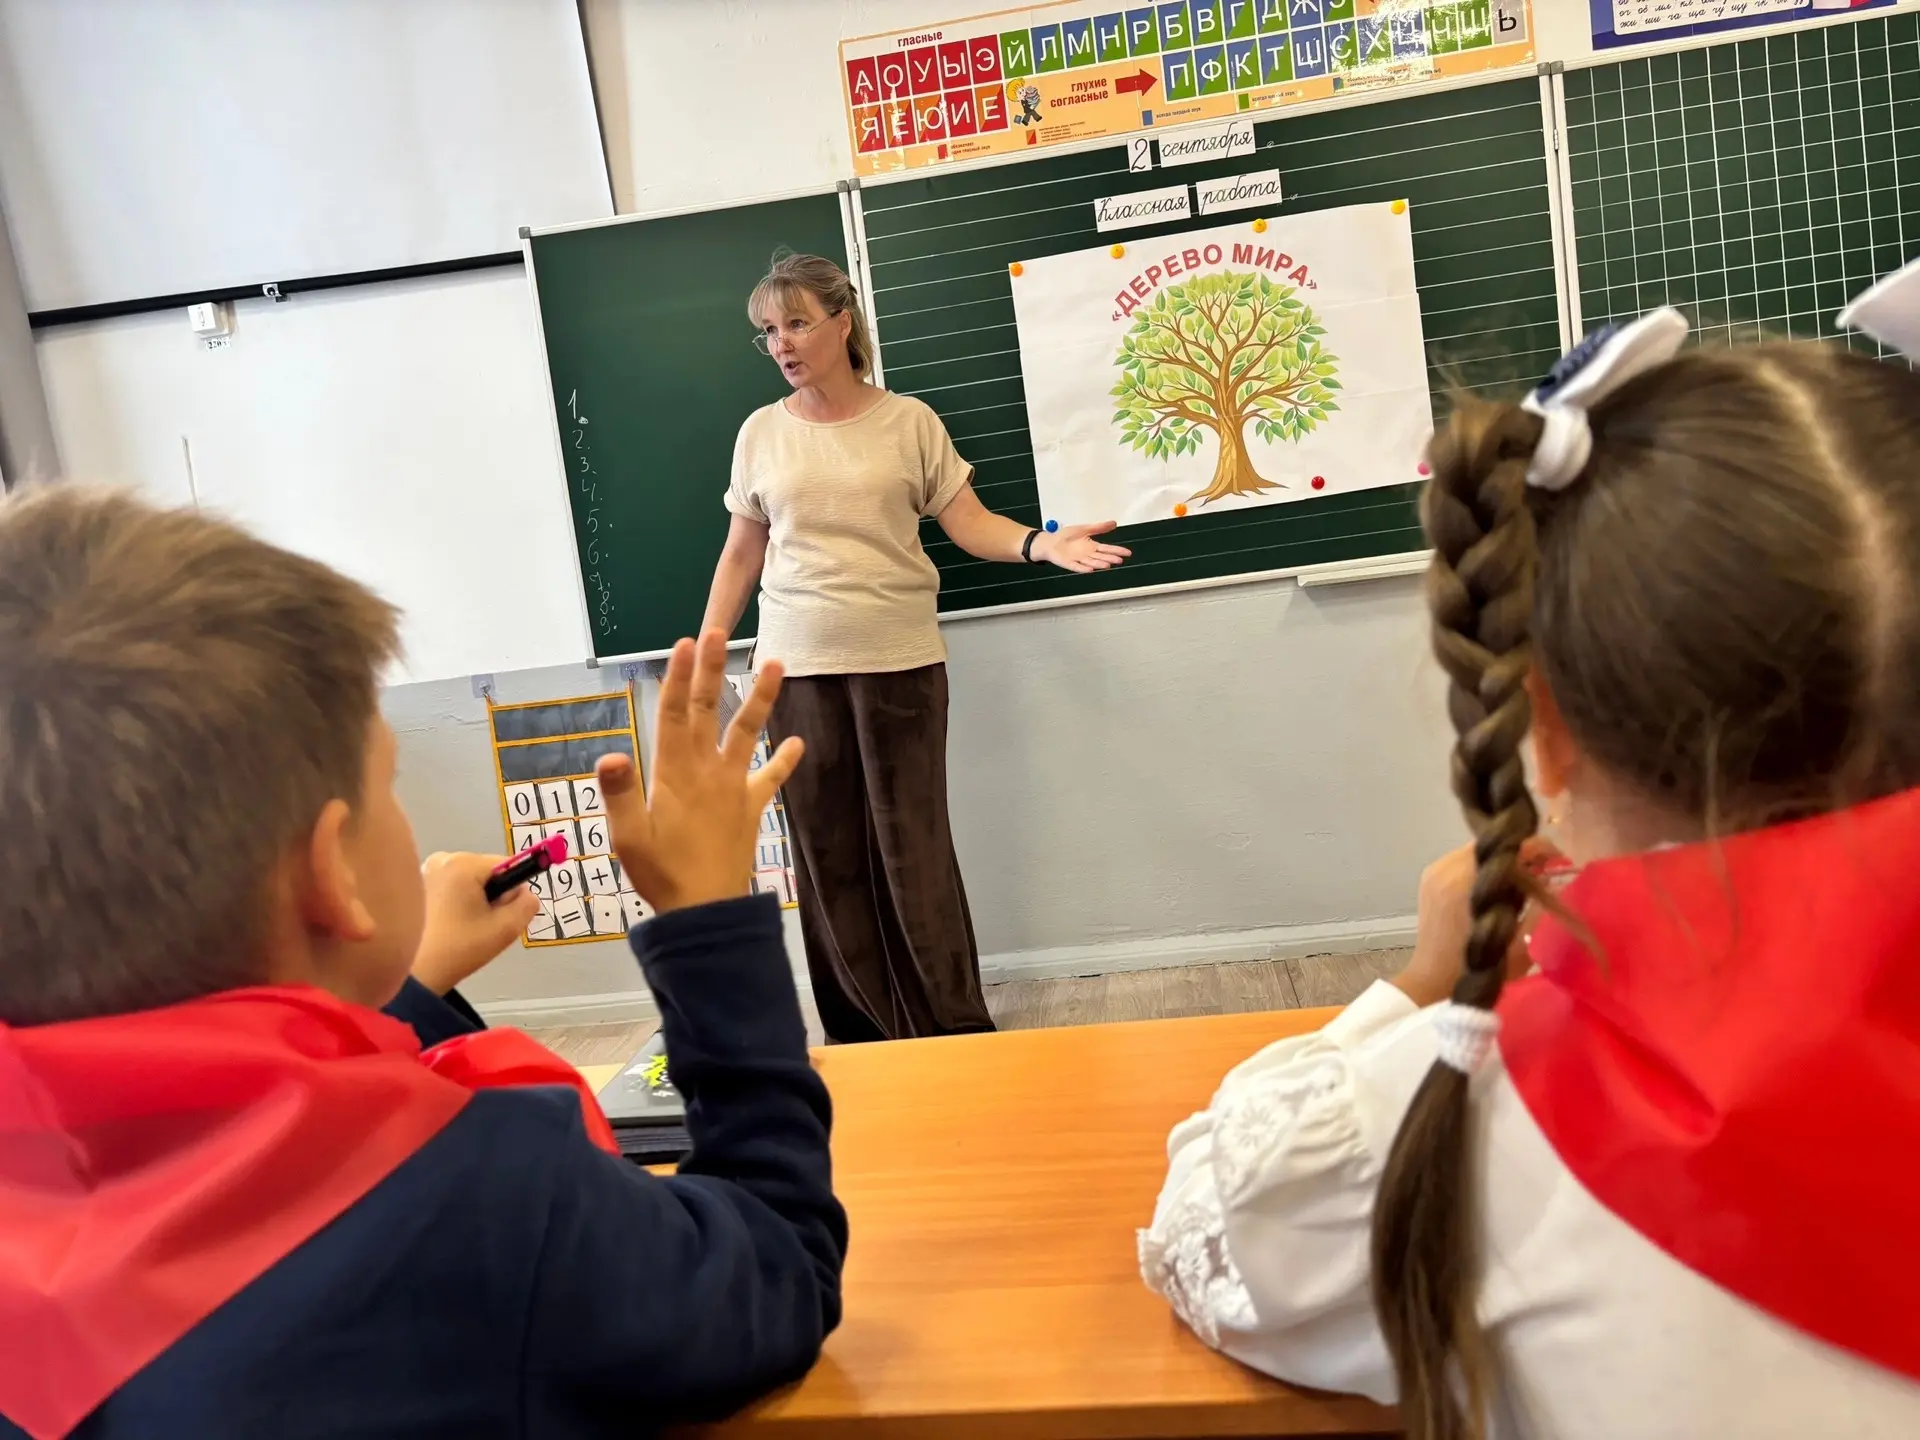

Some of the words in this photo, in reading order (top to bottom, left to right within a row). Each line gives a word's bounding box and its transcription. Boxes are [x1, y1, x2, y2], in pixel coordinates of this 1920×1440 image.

[855, 70, 874, 94] А
[883, 65, 904, 87] О
[914, 57, 932, 82] У
[942, 52, 966, 78] Ы
[976, 48, 996, 71] Э
[1007, 39, 1027, 69] Й
[1040, 35, 1058, 61] Л
[1067, 30, 1091, 56] М
[1101, 25, 1120, 50] Н
[1132, 20, 1150, 44] Р
[1165, 14, 1183, 39] Б
[1197, 8, 1216, 33] В
[1230, 2, 1245, 28] Г
[1262, 0, 1282, 24] Д
[897, 31, 943, 48] гласные
[1170, 63, 1189, 89] П
[1201, 59, 1222, 82] Ф
[1235, 52, 1252, 78] К
[1266, 46, 1284, 71] Т
[1331, 35, 1351, 59] С
[1365, 28, 1386, 54] Х
[1050, 89, 1109, 108] согласные
[1071, 77, 1107, 93] глухие
[861, 117, 880, 141] Я
[916, 106, 943, 131] Ю
[951, 101, 970, 125] И
[982, 96, 1000, 120] Е
[1131, 138, 1148, 171] 2
[1162, 122, 1253, 158] сентября
[1098, 196, 1189, 222] Классная
[1201, 175, 1279, 215] работа
[551, 790, 564, 814] 1
[582, 786, 599, 811] 2
[588, 822, 603, 848] 6
[557, 869, 573, 894] 9
